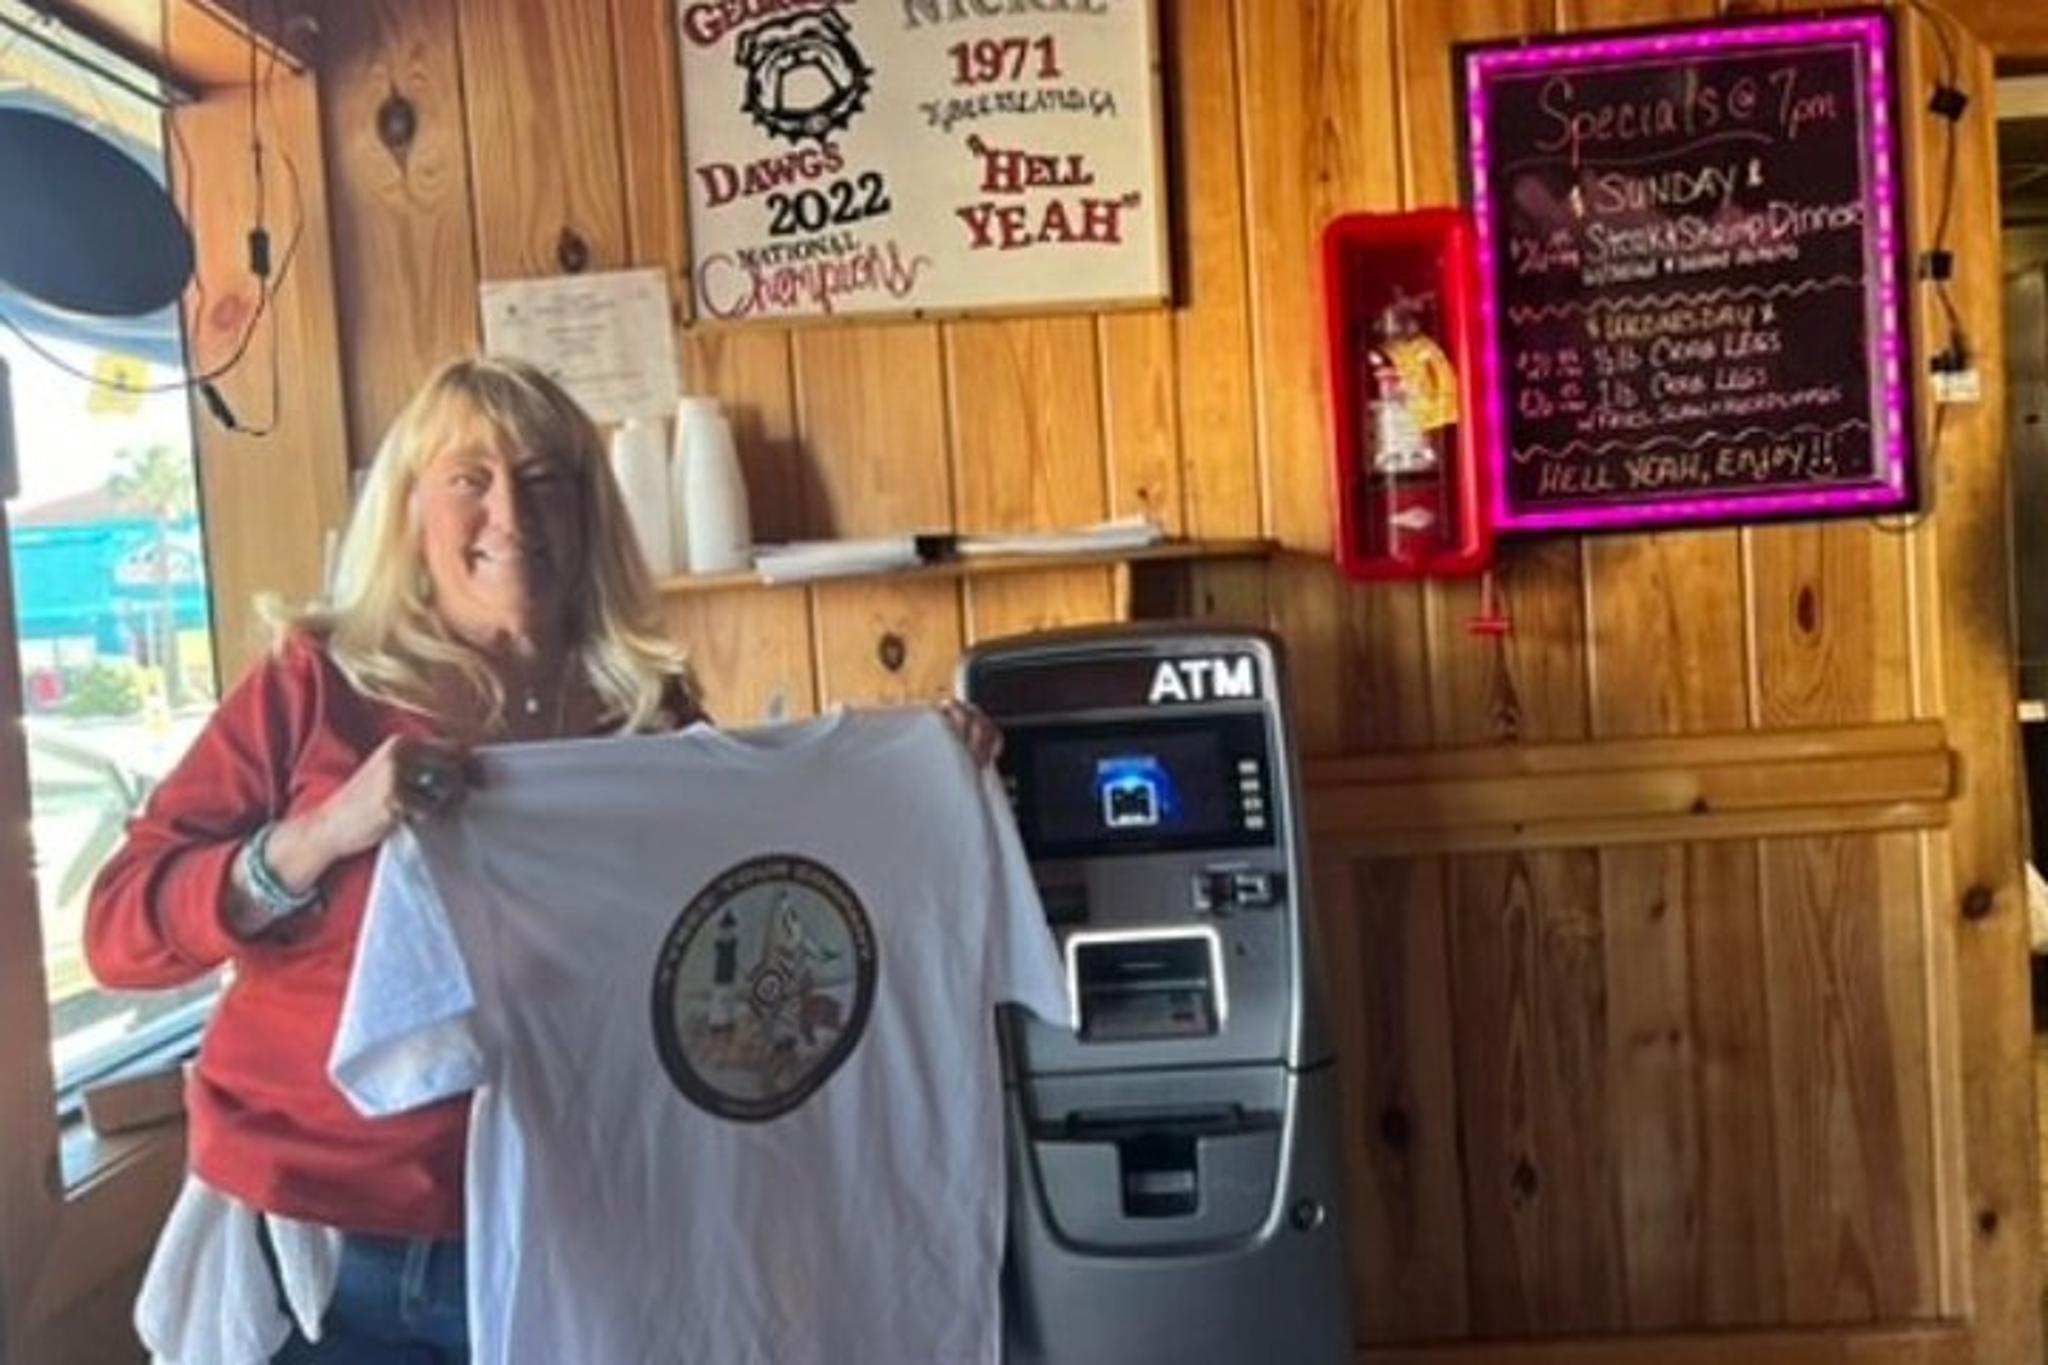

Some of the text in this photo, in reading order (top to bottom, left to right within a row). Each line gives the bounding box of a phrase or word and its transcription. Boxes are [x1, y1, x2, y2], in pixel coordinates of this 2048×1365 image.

[948, 33, 1062, 86] 1971
[1536, 68, 1719, 168] Specials
[1728, 76, 1756, 119] @
[696, 141, 844, 208] DAWGS
[1598, 164, 1738, 212] SUNDAY
[766, 170, 892, 236] 2022
[737, 232, 860, 272] NATIONAL
[1538, 461, 1614, 496] HELL
[1149, 656, 1254, 703] ATM
